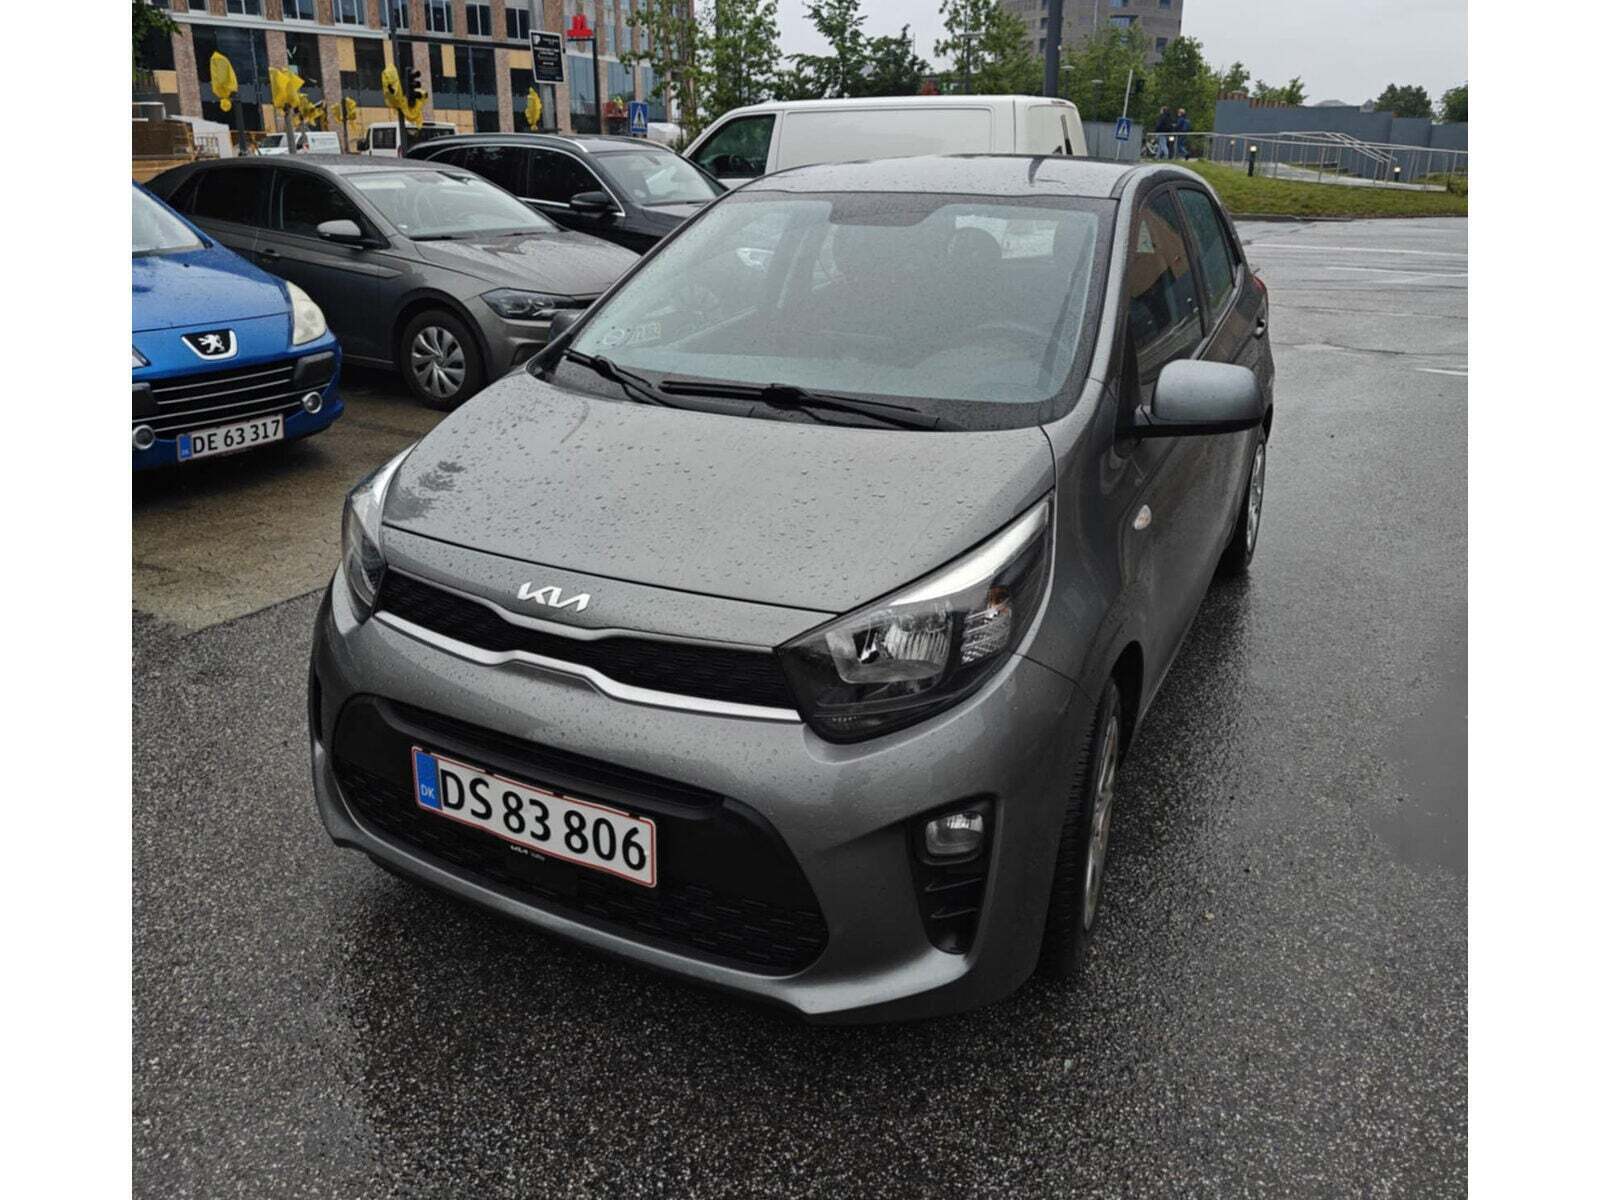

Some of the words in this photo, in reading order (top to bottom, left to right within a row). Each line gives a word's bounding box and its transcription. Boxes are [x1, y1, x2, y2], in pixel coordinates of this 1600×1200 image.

[193, 432, 218, 454] DE
[224, 427, 245, 447] 63
[250, 419, 281, 442] 317
[517, 580, 591, 613] KIA
[420, 784, 436, 800] DK
[440, 768, 493, 820] DS
[501, 790, 551, 842] 83
[563, 809, 647, 871] 806
